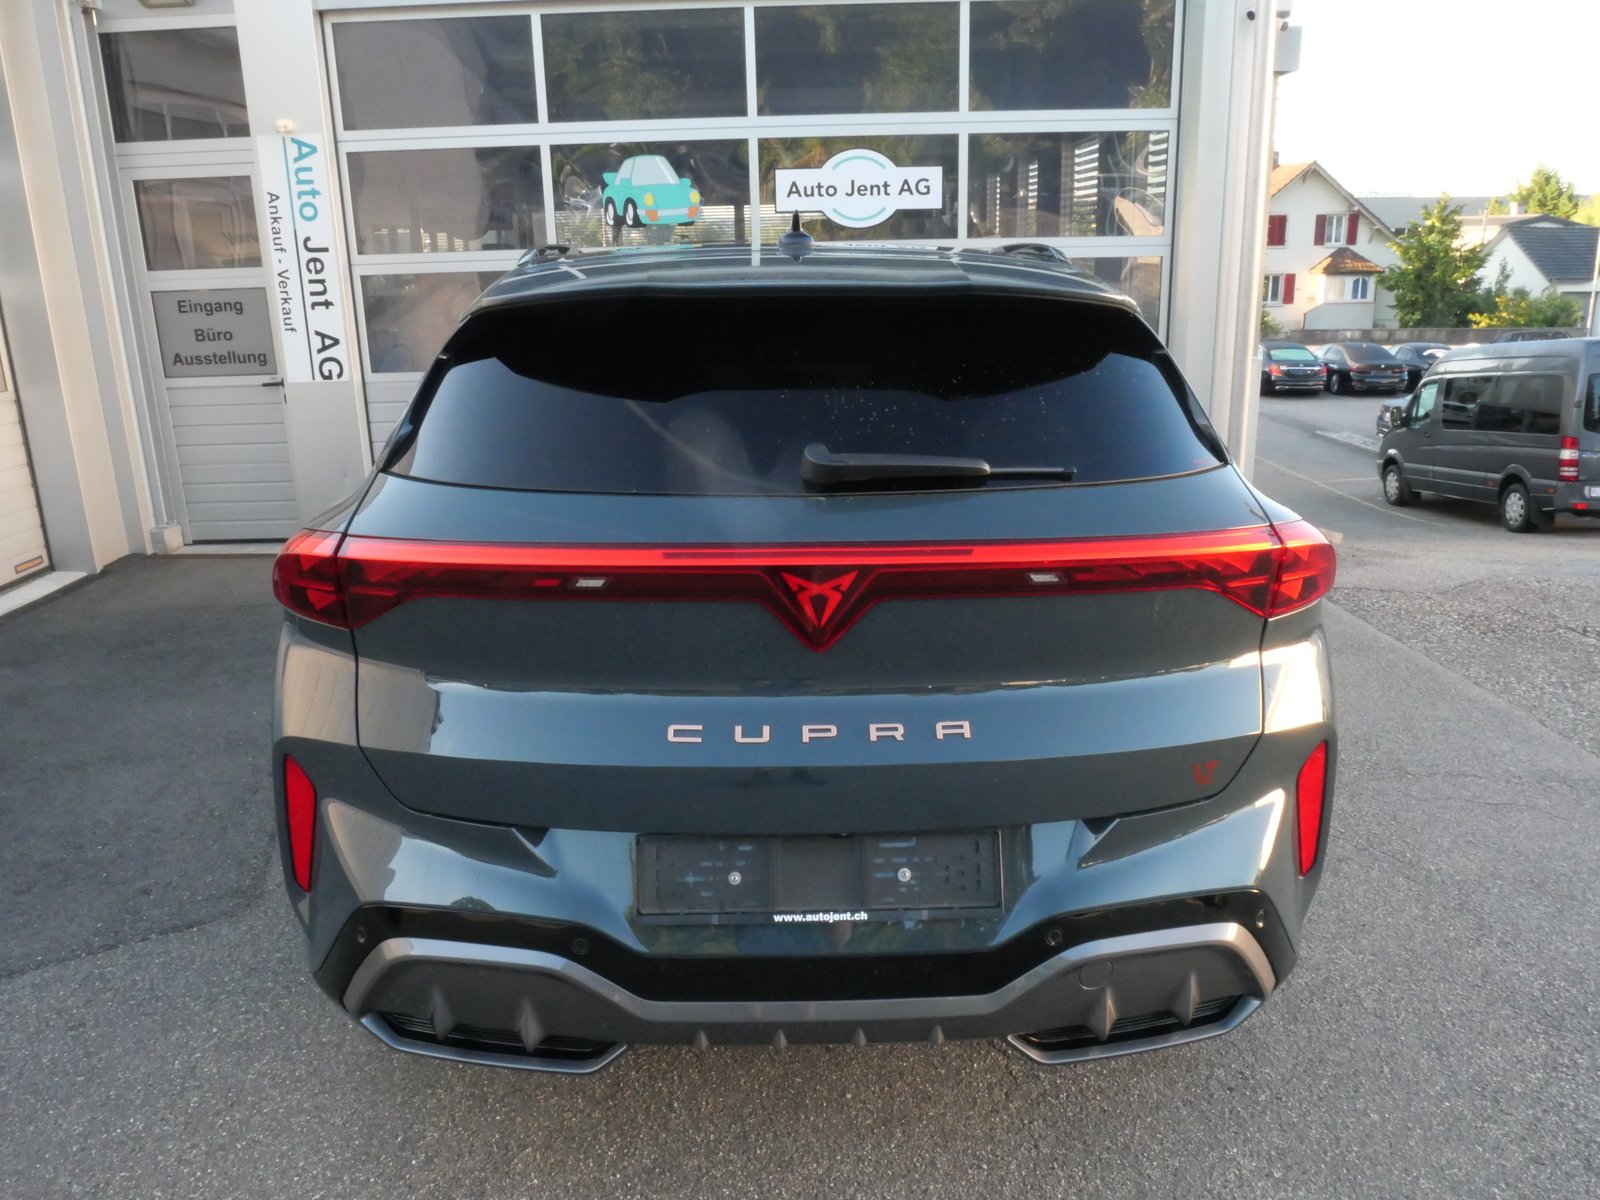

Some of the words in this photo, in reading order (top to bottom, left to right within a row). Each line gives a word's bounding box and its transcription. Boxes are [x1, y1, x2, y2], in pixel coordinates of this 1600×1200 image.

[290, 137, 321, 221] Auto
[786, 181, 838, 198] Auto
[844, 179, 891, 197] Jent
[897, 178, 931, 196] AG
[266, 191, 287, 253] Ankauf
[277, 269, 297, 333] Verkauf
[303, 236, 335, 310] Jent
[177, 300, 244, 316] Eingang
[194, 328, 234, 342] Büro
[173, 351, 268, 367] Ausstellung
[313, 329, 344, 381] AG
[667, 721, 971, 743] CUPRA
[773, 910, 869, 923] www.autojent.ch
